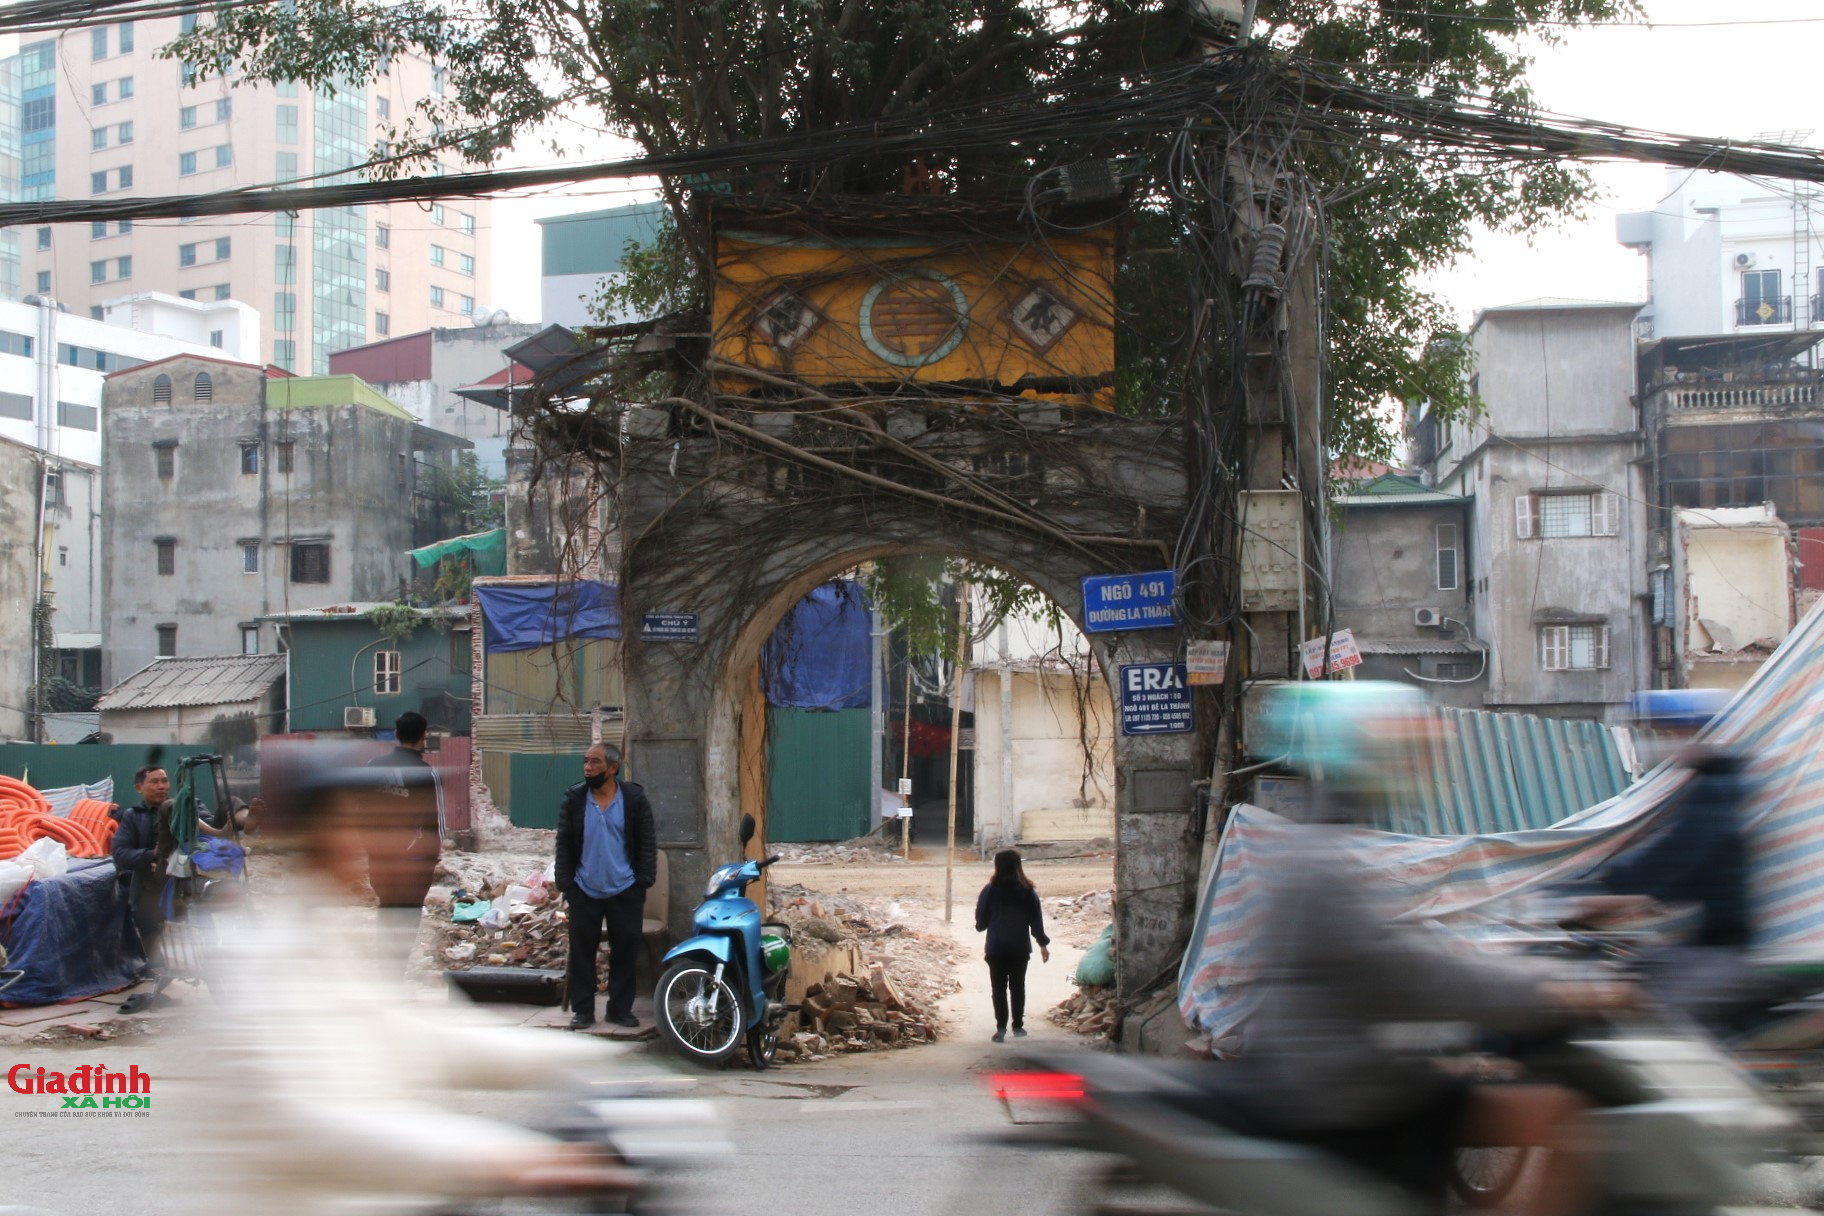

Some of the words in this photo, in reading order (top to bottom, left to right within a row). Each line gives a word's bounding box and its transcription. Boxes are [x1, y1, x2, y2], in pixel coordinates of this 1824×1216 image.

[1101, 581, 1132, 601] NGÕ
[1140, 581, 1165, 598] 491
[1089, 606, 1126, 623] ĐƯỜNG
[1127, 607, 1141, 620] LA
[1142, 602, 1171, 618] THÀN
[1128, 667, 1183, 690] ERA
